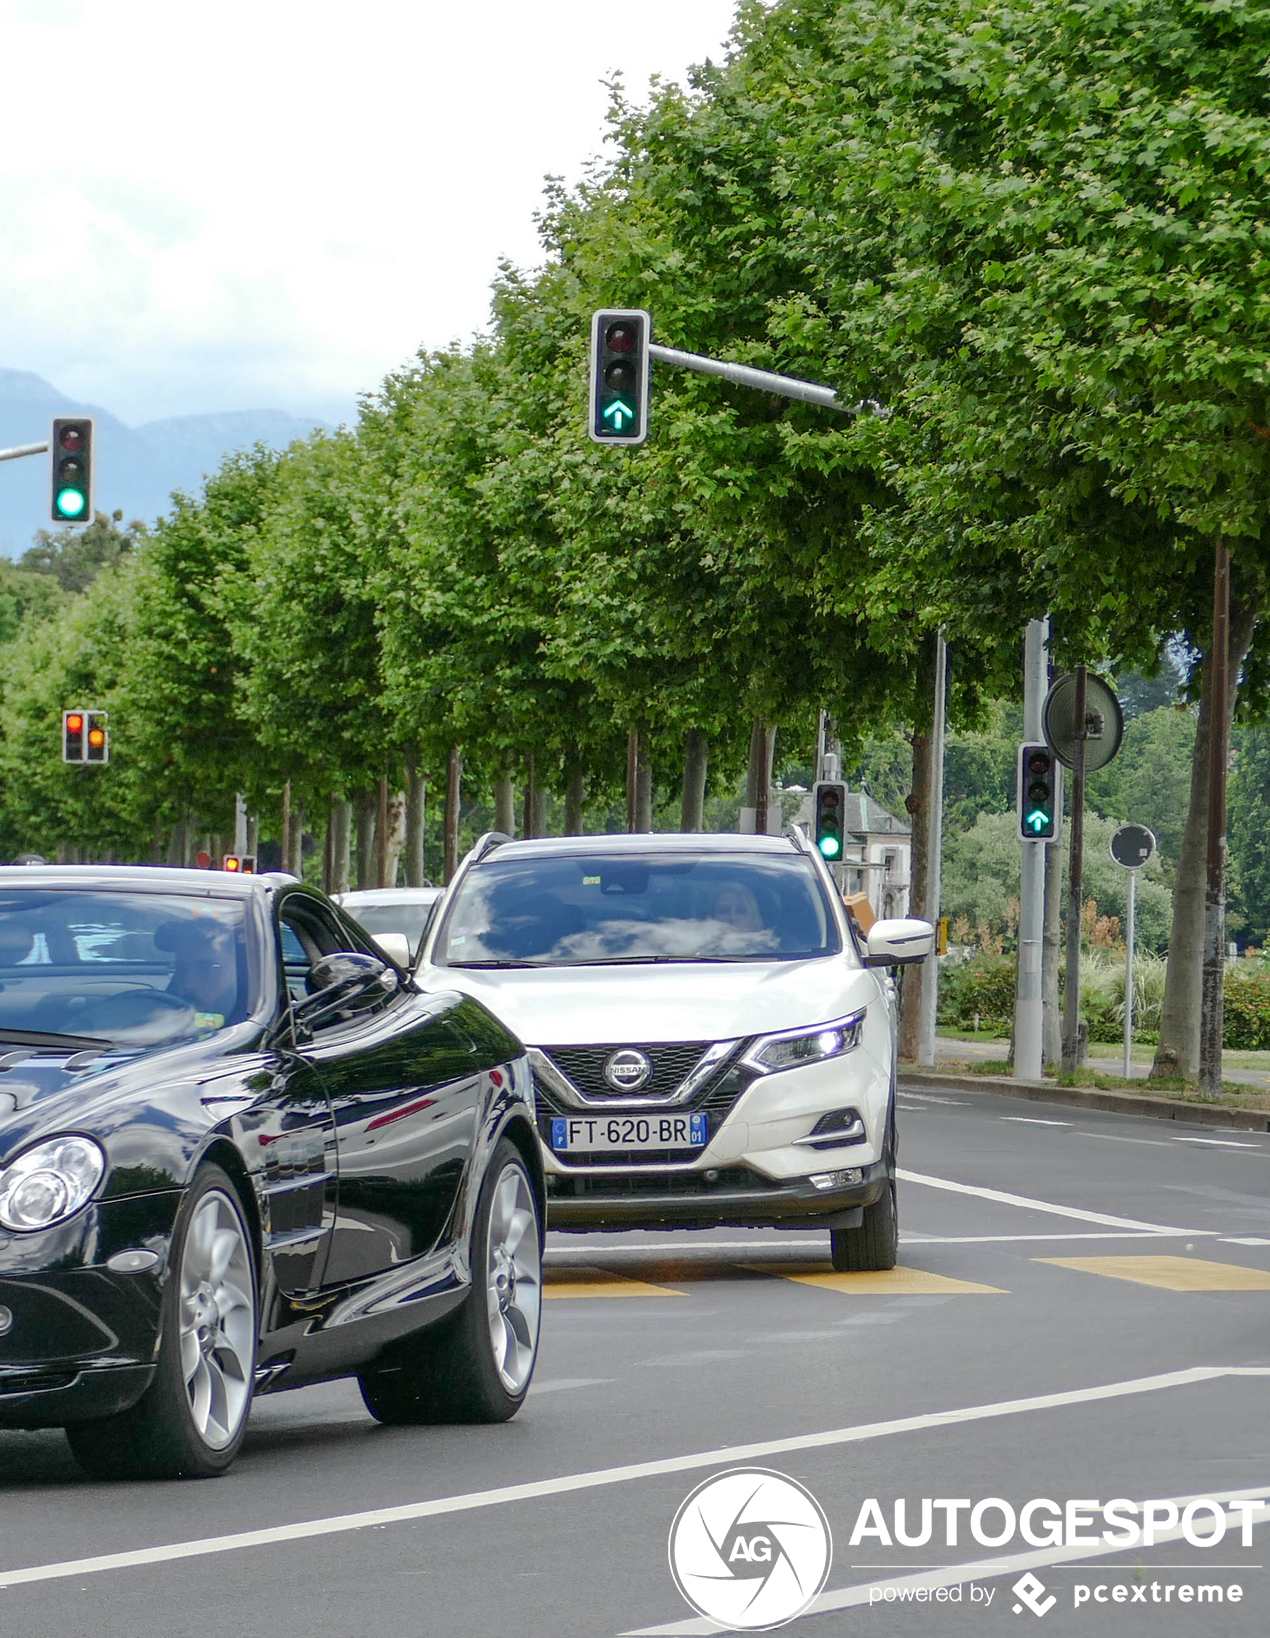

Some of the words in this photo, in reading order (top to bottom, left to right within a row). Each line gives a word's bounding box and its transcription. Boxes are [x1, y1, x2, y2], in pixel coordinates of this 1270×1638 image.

[610, 1066, 647, 1075] NISSAN
[569, 1119, 687, 1144] FT-620-BR
[691, 1131, 703, 1143] 01
